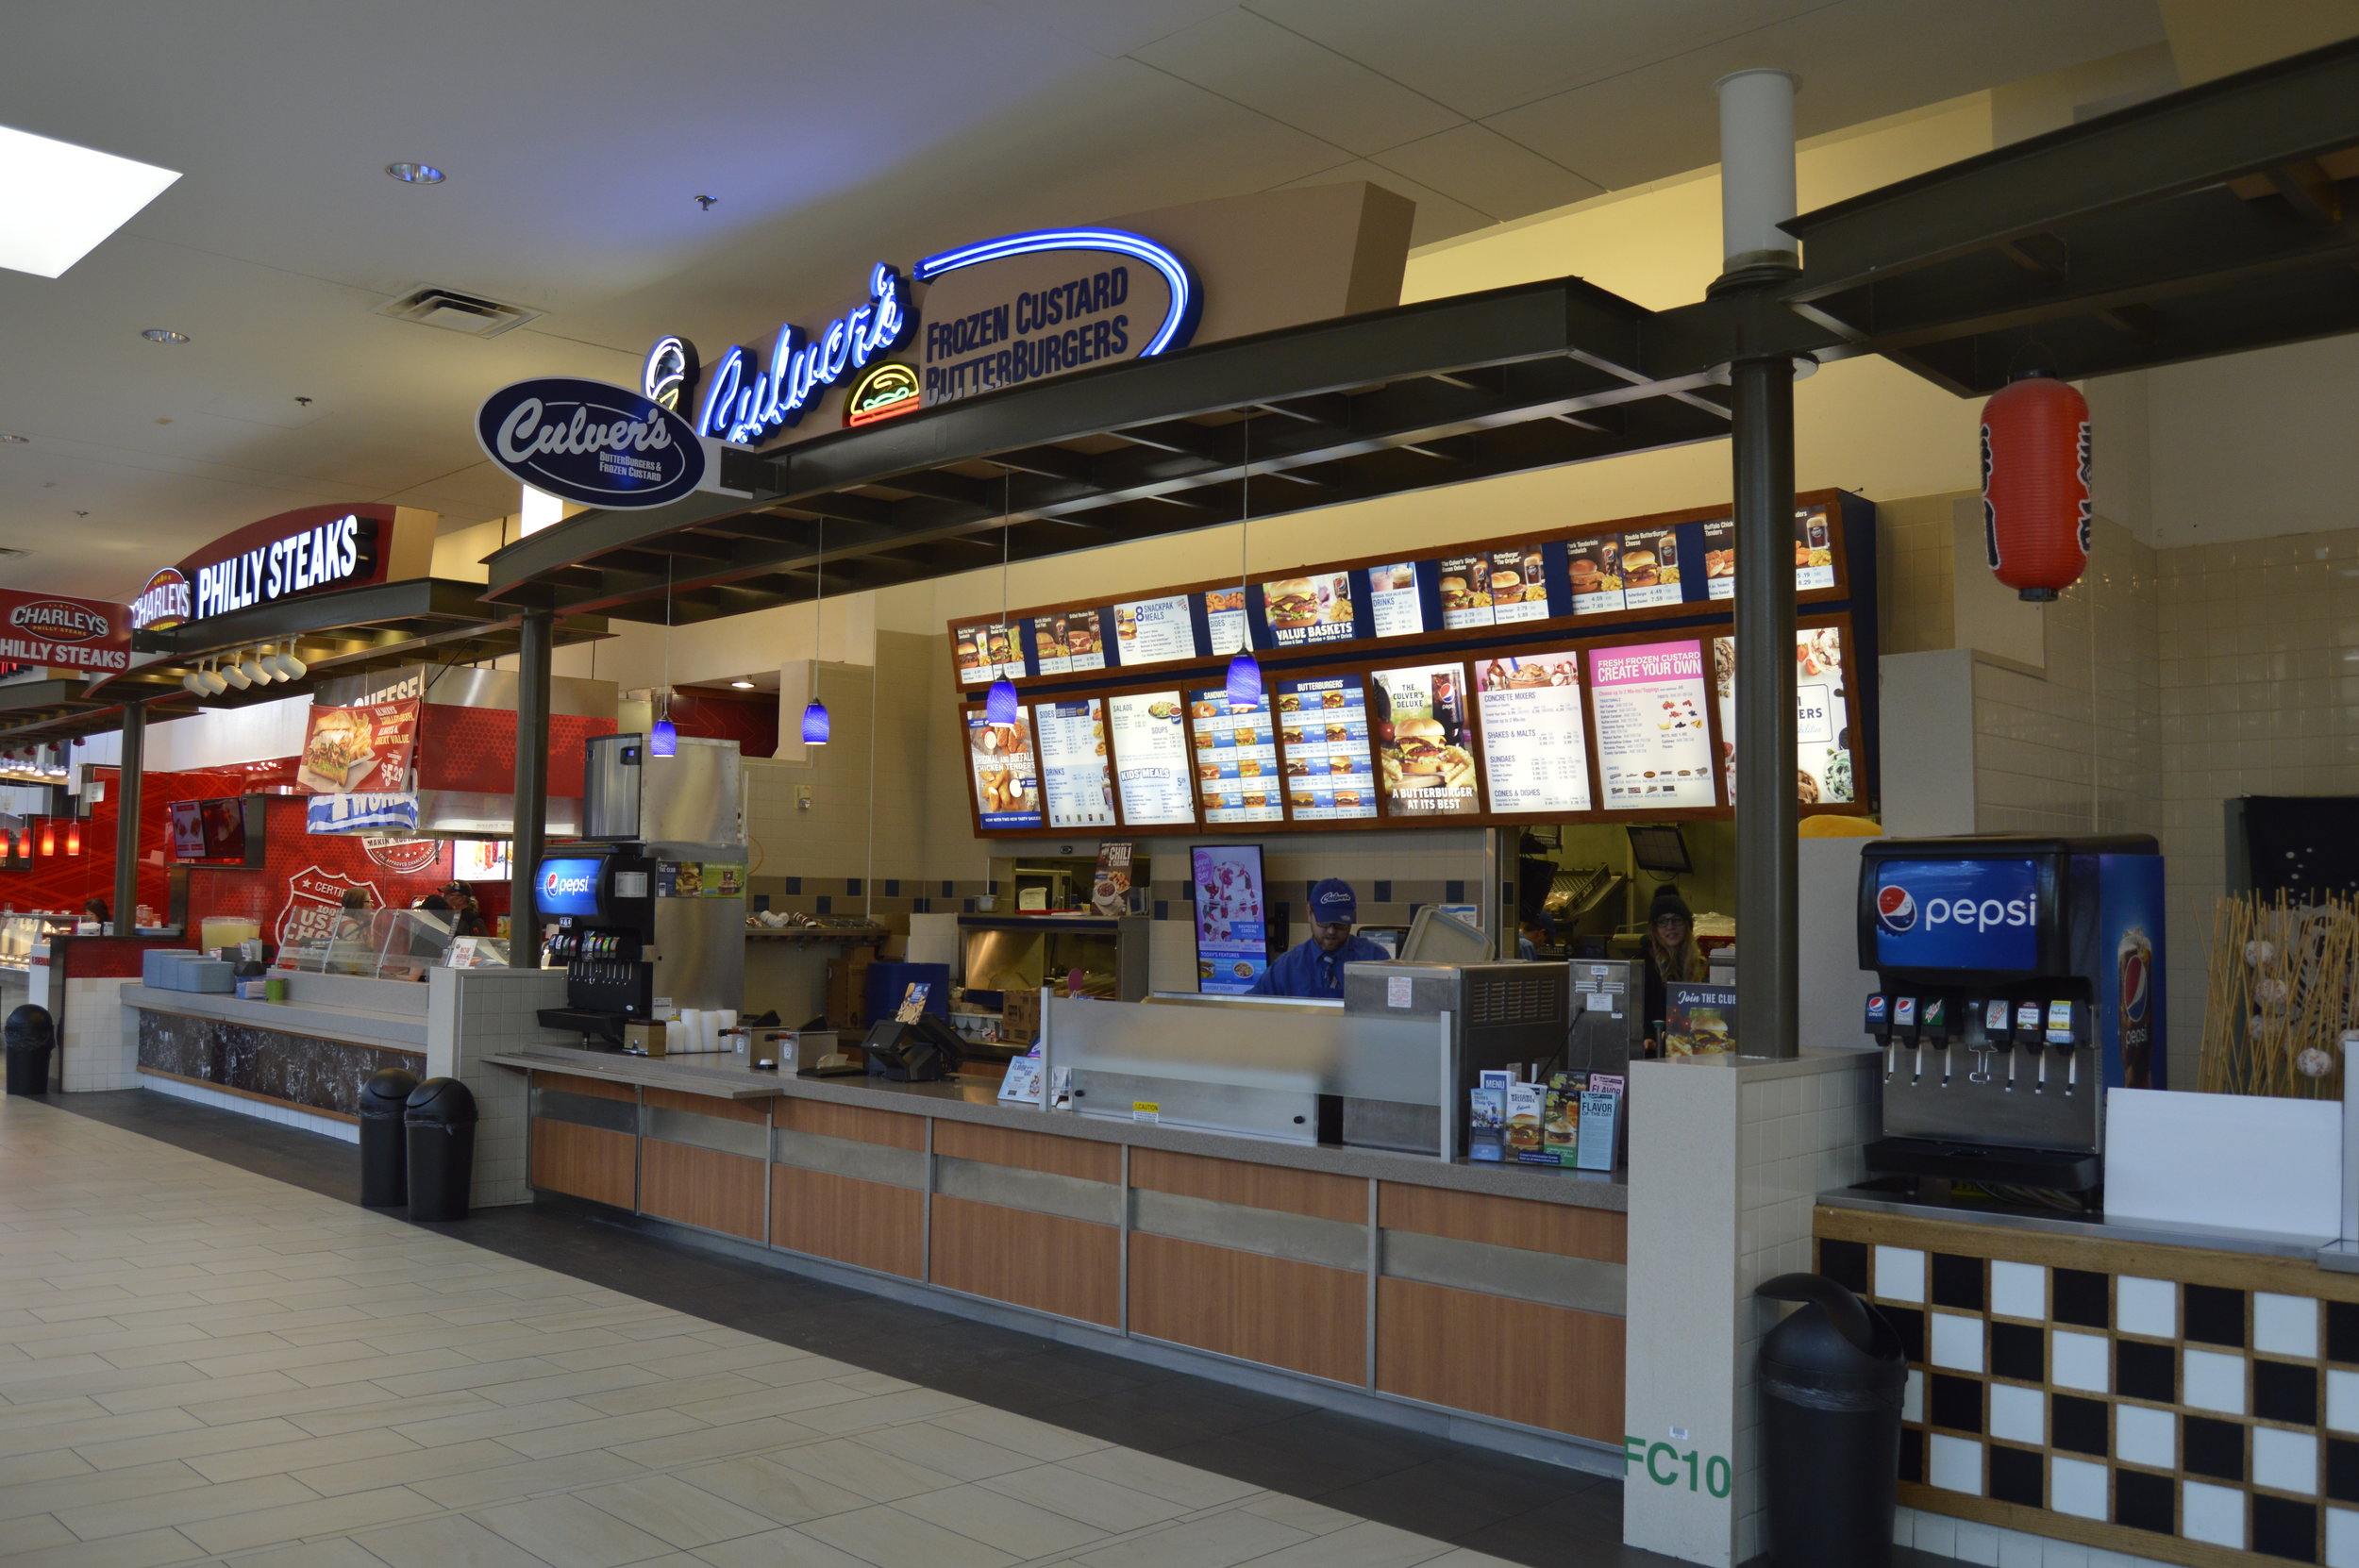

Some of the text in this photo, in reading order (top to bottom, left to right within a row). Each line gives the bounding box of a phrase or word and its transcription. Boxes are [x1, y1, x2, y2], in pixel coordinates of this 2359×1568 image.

[926, 266, 1129, 364] FROZEN CUSTARD
[925, 314, 1129, 408] BUTTERBURGERS
[496, 397, 672, 463] Culver's
[599, 461, 661, 482] FROZEN CUSTARD
[655, 461, 662, 472] &
[1625, 529, 1668, 542] Double ButterBurger
[1494, 551, 1519, 560] ButterBurger
[196, 513, 359, 620] PHILLY STEAKS
[133, 579, 191, 630] CHARLEYS
[1373, 597, 1395, 607] DRINKS
[1135, 606, 1145, 623] 8
[1145, 611, 1164, 622] MEALS
[11, 607, 109, 637] CHARLEYS
[59, 627, 87, 637] STEAKS
[1276, 622, 1352, 641] VALUE BASKETS
[0, 638, 126, 669] HILLY STEAKS
[1598, 651, 1700, 668] FRESH FROZEN CUSTARD
[1598, 659, 1701, 683] CREATE YOUR OWN
[1297, 680, 1344, 692] BUTTERBURGERS
[1204, 690, 1228, 700] SANDWIC
[1393, 691, 1425, 700] CULVER'S
[1484, 692, 1536, 703] CONCRETE MIXERS
[1113, 704, 1132, 712] SALADS
[1397, 699, 1423, 709] DELUXE
[1039, 710, 1055, 719] SIDES
[1151, 726, 1168, 735] SOUPS
[1487, 730, 1510, 740] SHAKES
[1490, 755, 1515, 763] SUNDAES
[979, 762, 1035, 772] HICKEN TENDERS
[1046, 768, 1064, 776] DRINKS
[1120, 768, 1170, 781] KIDS' MEALS
[1392, 787, 1473, 799] A BUTTERBURGER
[1408, 799, 1460, 809] AT ITS BEST
[1110, 846, 1131, 860] CHILI
[314, 881, 347, 898] CERTIF
[559, 876, 589, 895] pepsi
[1925, 892, 2038, 933] pepsi
[1678, 991, 1700, 1005] Join
[1701, 993, 1716, 1004] THE
[2126, 1028, 2148, 1049] pepsi
[1485, 1079, 1505, 1089] MENU
[1581, 1102, 1613, 1112] FLAVOR
[1623, 1435, 1732, 1499] FC10
